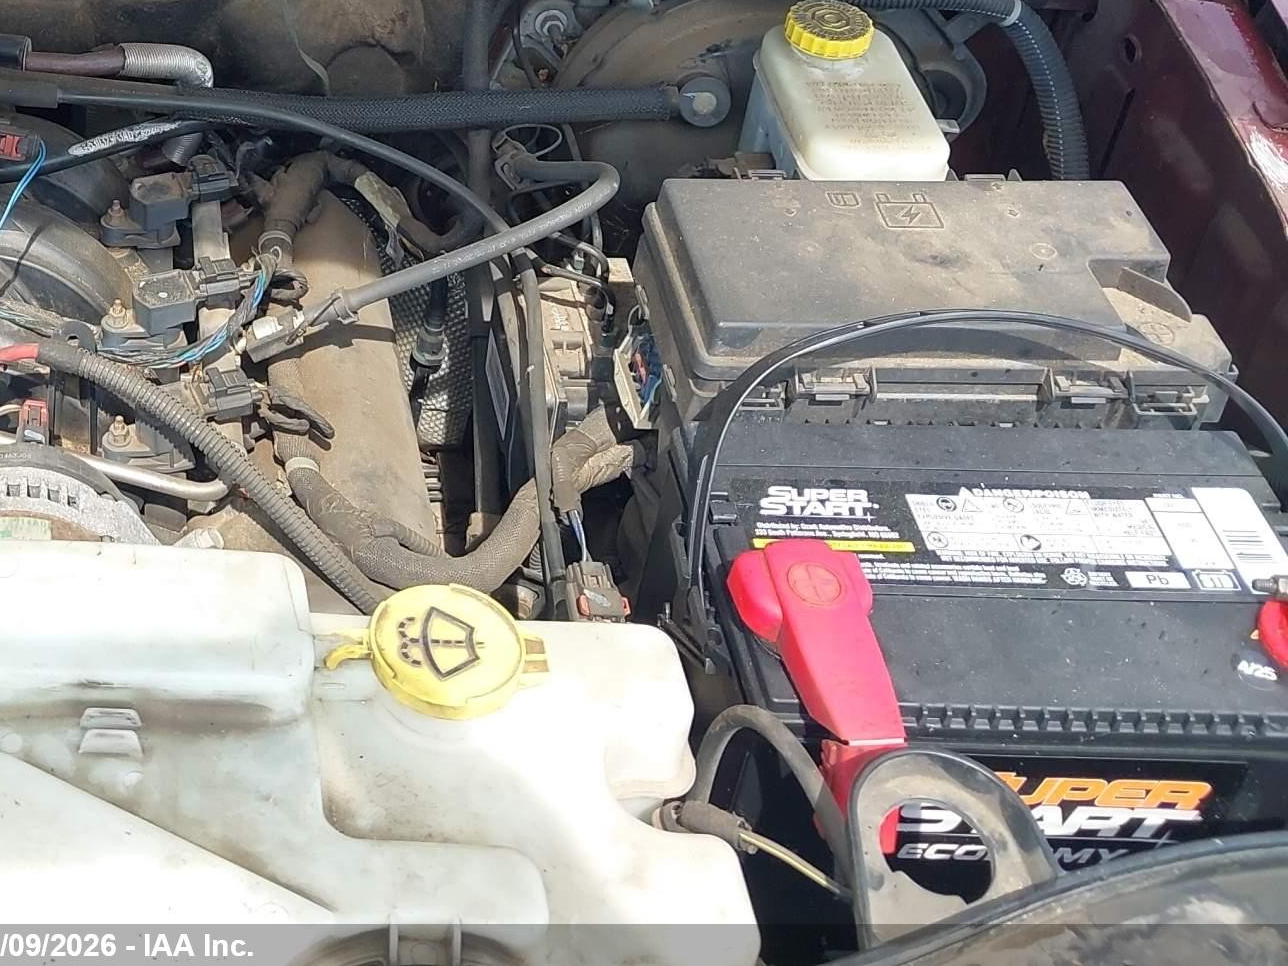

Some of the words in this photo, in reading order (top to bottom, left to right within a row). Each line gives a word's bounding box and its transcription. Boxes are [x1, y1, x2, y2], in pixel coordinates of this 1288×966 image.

[768, 486, 868, 502] SUPER
[759, 497, 873, 516] START
[1146, 574, 1169, 585] Pb
